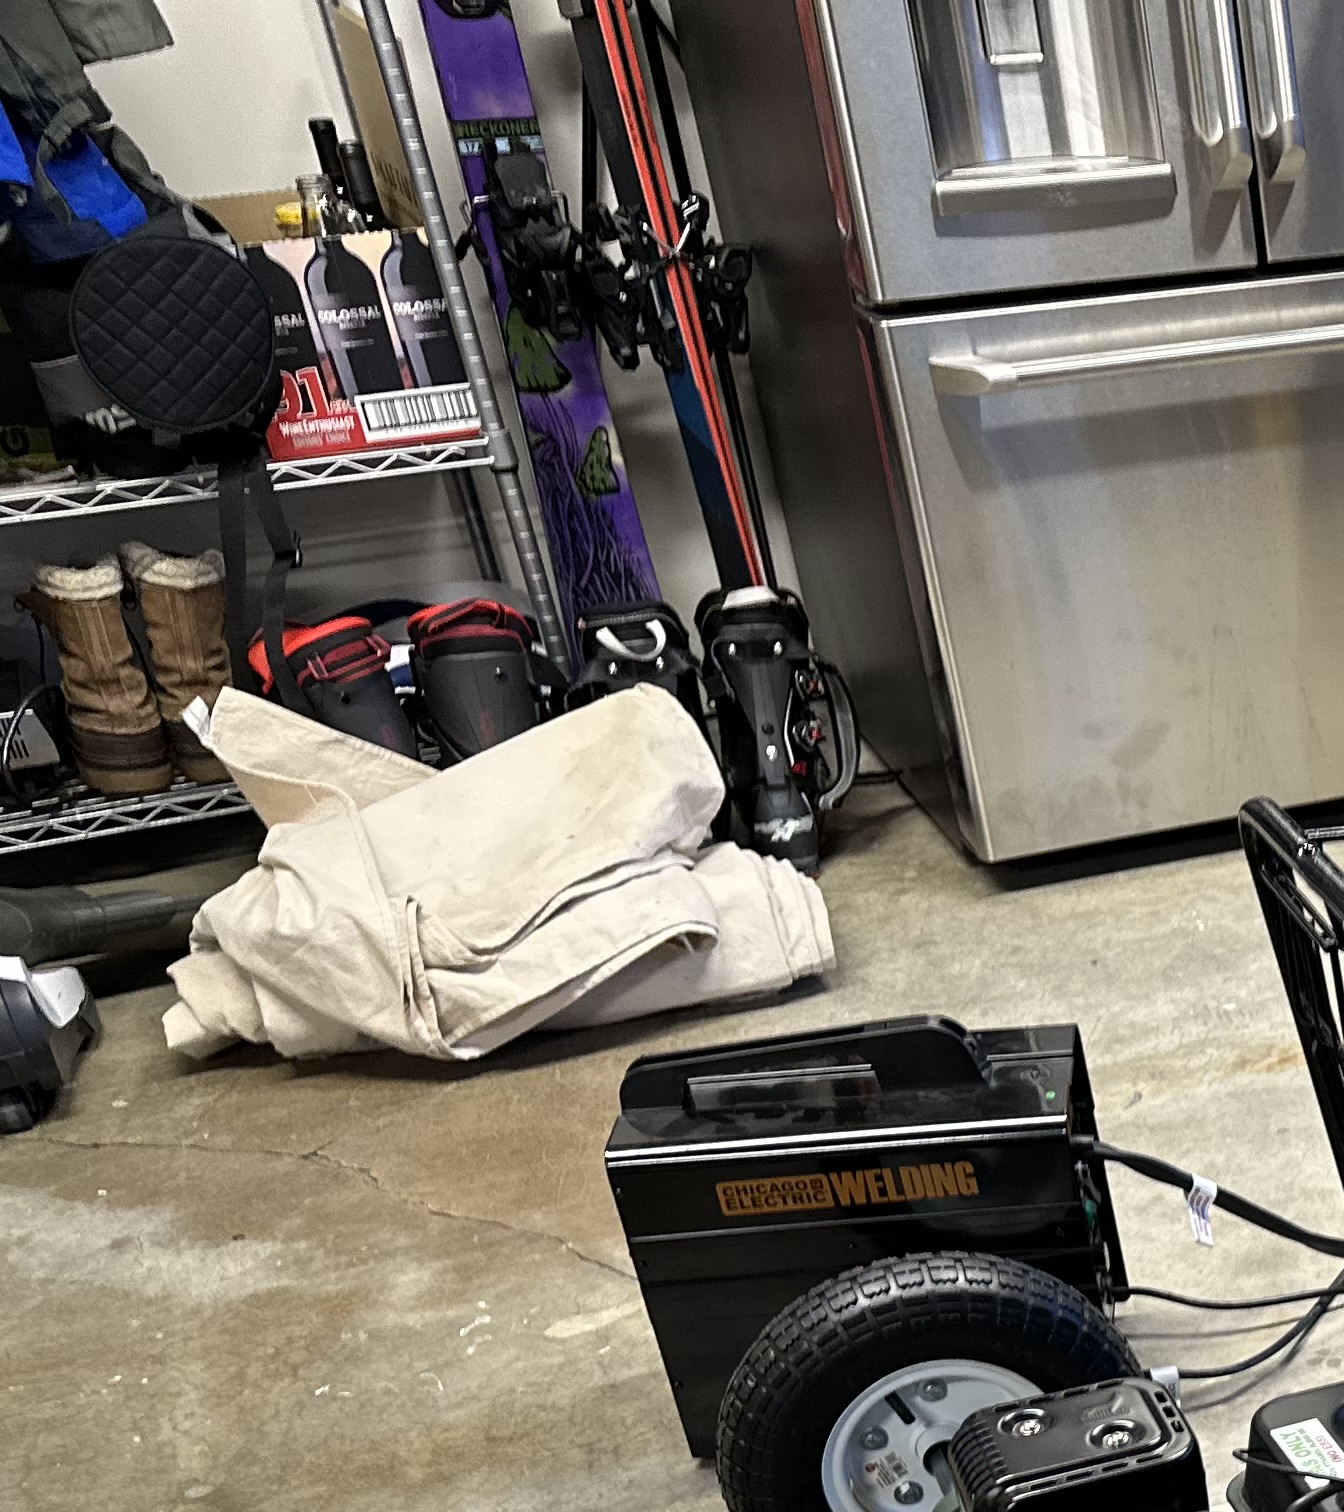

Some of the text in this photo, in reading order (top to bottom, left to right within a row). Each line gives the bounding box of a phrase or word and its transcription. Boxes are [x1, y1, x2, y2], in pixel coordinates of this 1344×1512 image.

[722, 1179, 807, 1198] CHICAGO
[829, 1159, 980, 1208] WELDING
[726, 1191, 828, 1212] ELECTRIC
[1280, 1431, 1312, 1459] ONLY
